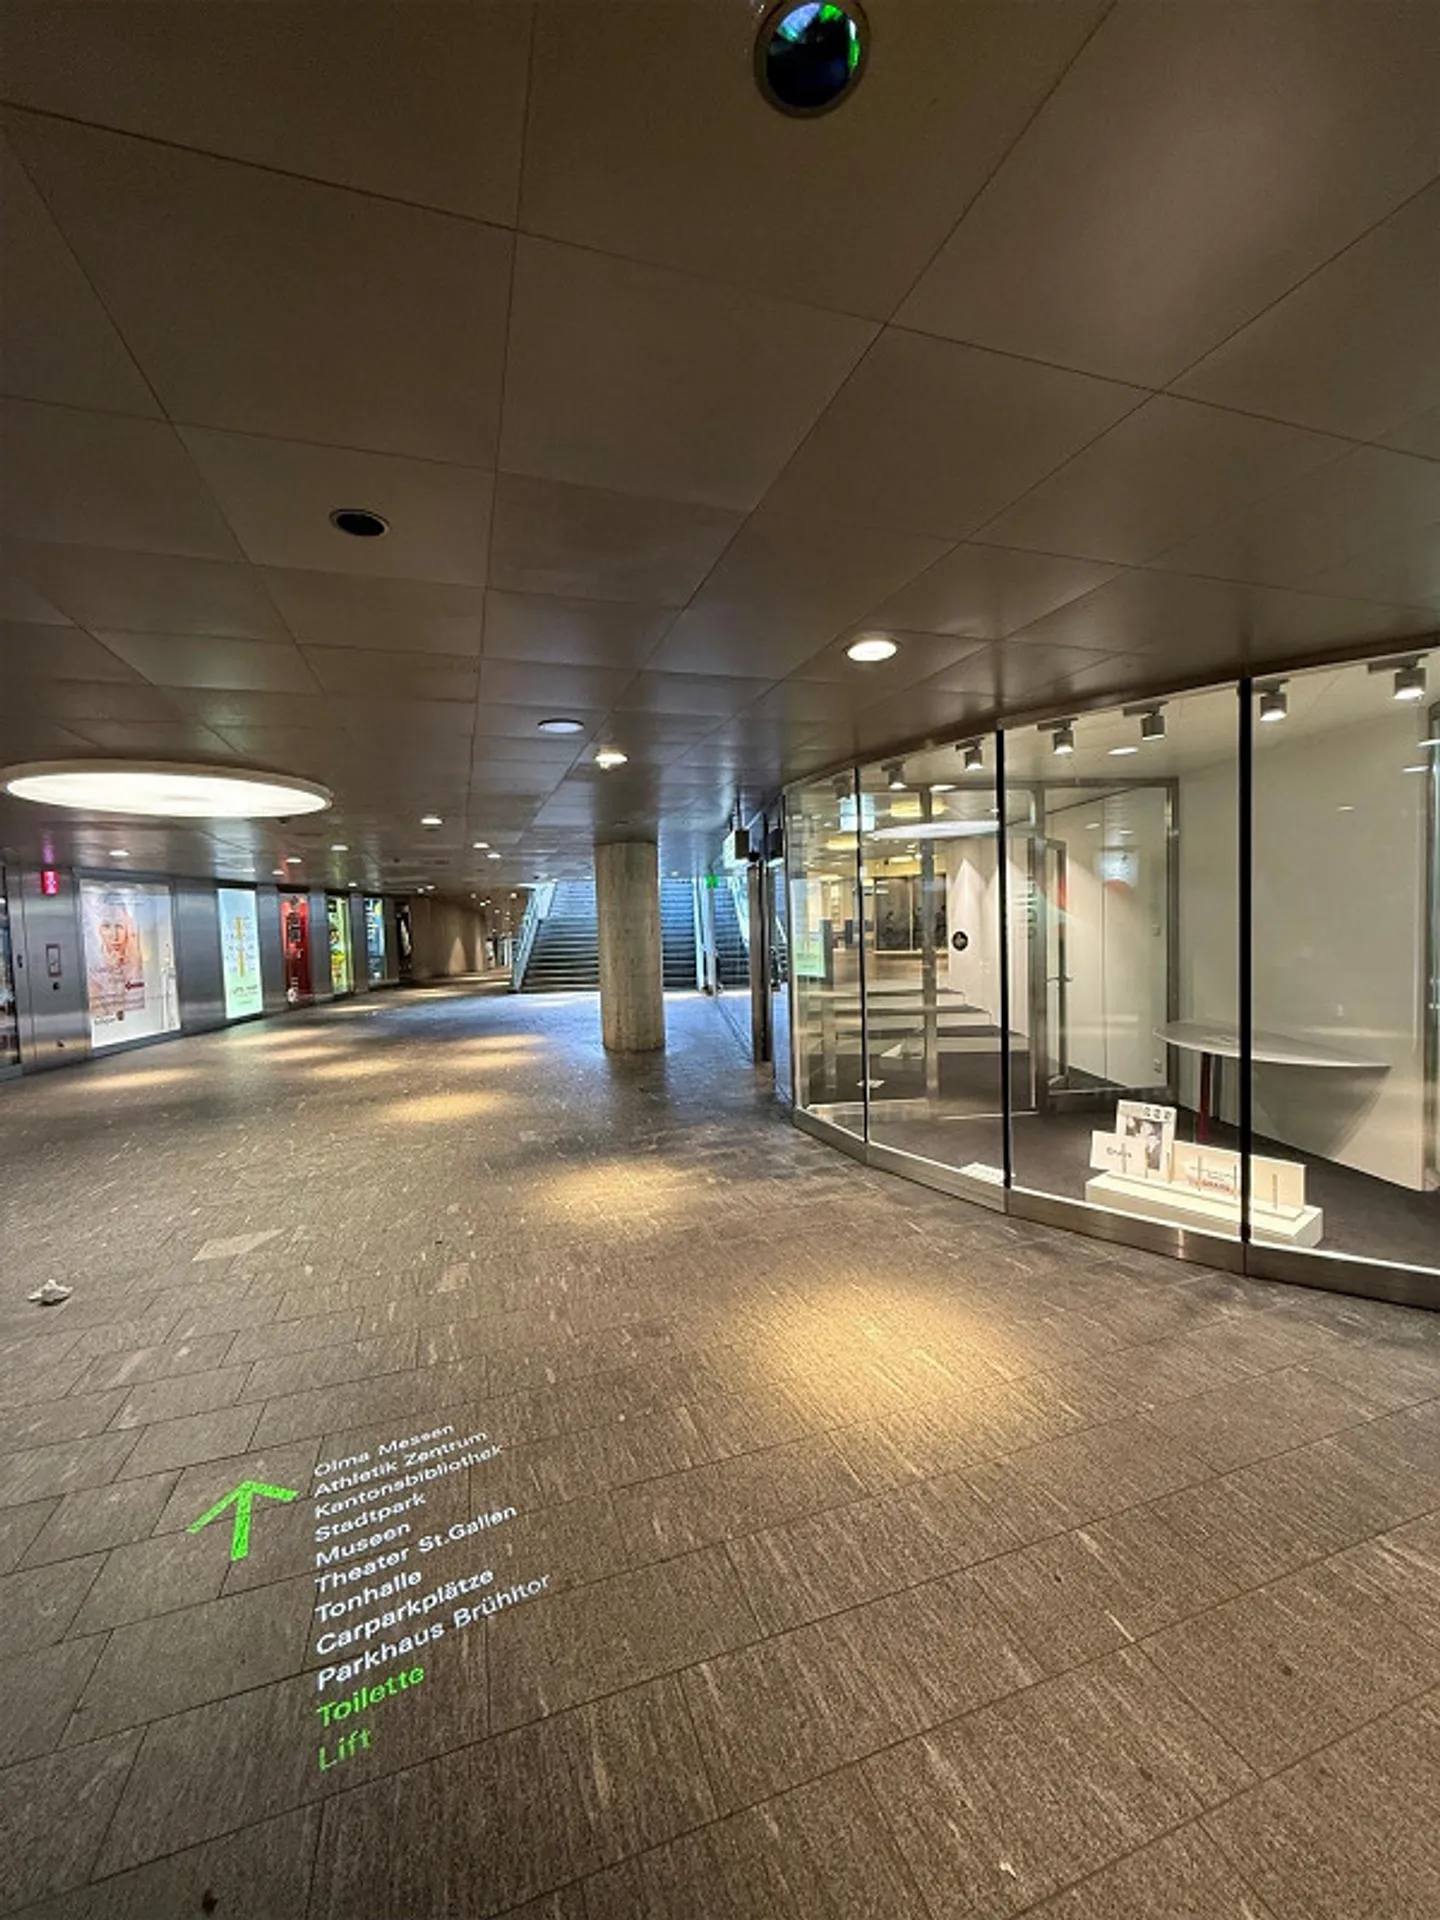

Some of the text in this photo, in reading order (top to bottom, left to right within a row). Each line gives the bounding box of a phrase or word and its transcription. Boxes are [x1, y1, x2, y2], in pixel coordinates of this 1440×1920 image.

[313, 1431, 488, 1497] Athletik Zentrum
[314, 1424, 454, 1477] Olma Messen
[315, 1445, 503, 1520] Kantonsbibliothek
[314, 1493, 427, 1542] Stadtpark
[315, 1523, 411, 1568] Museen
[315, 1505, 517, 1593] Theater St.Gallen
[314, 1570, 422, 1623] Tonhalle
[316, 1569, 494, 1655] Carparkplätze
[318, 1574, 550, 1691] Parkhaus Brühltor
[316, 1665, 425, 1727] Toilette
[318, 1728, 371, 1772] Lift
